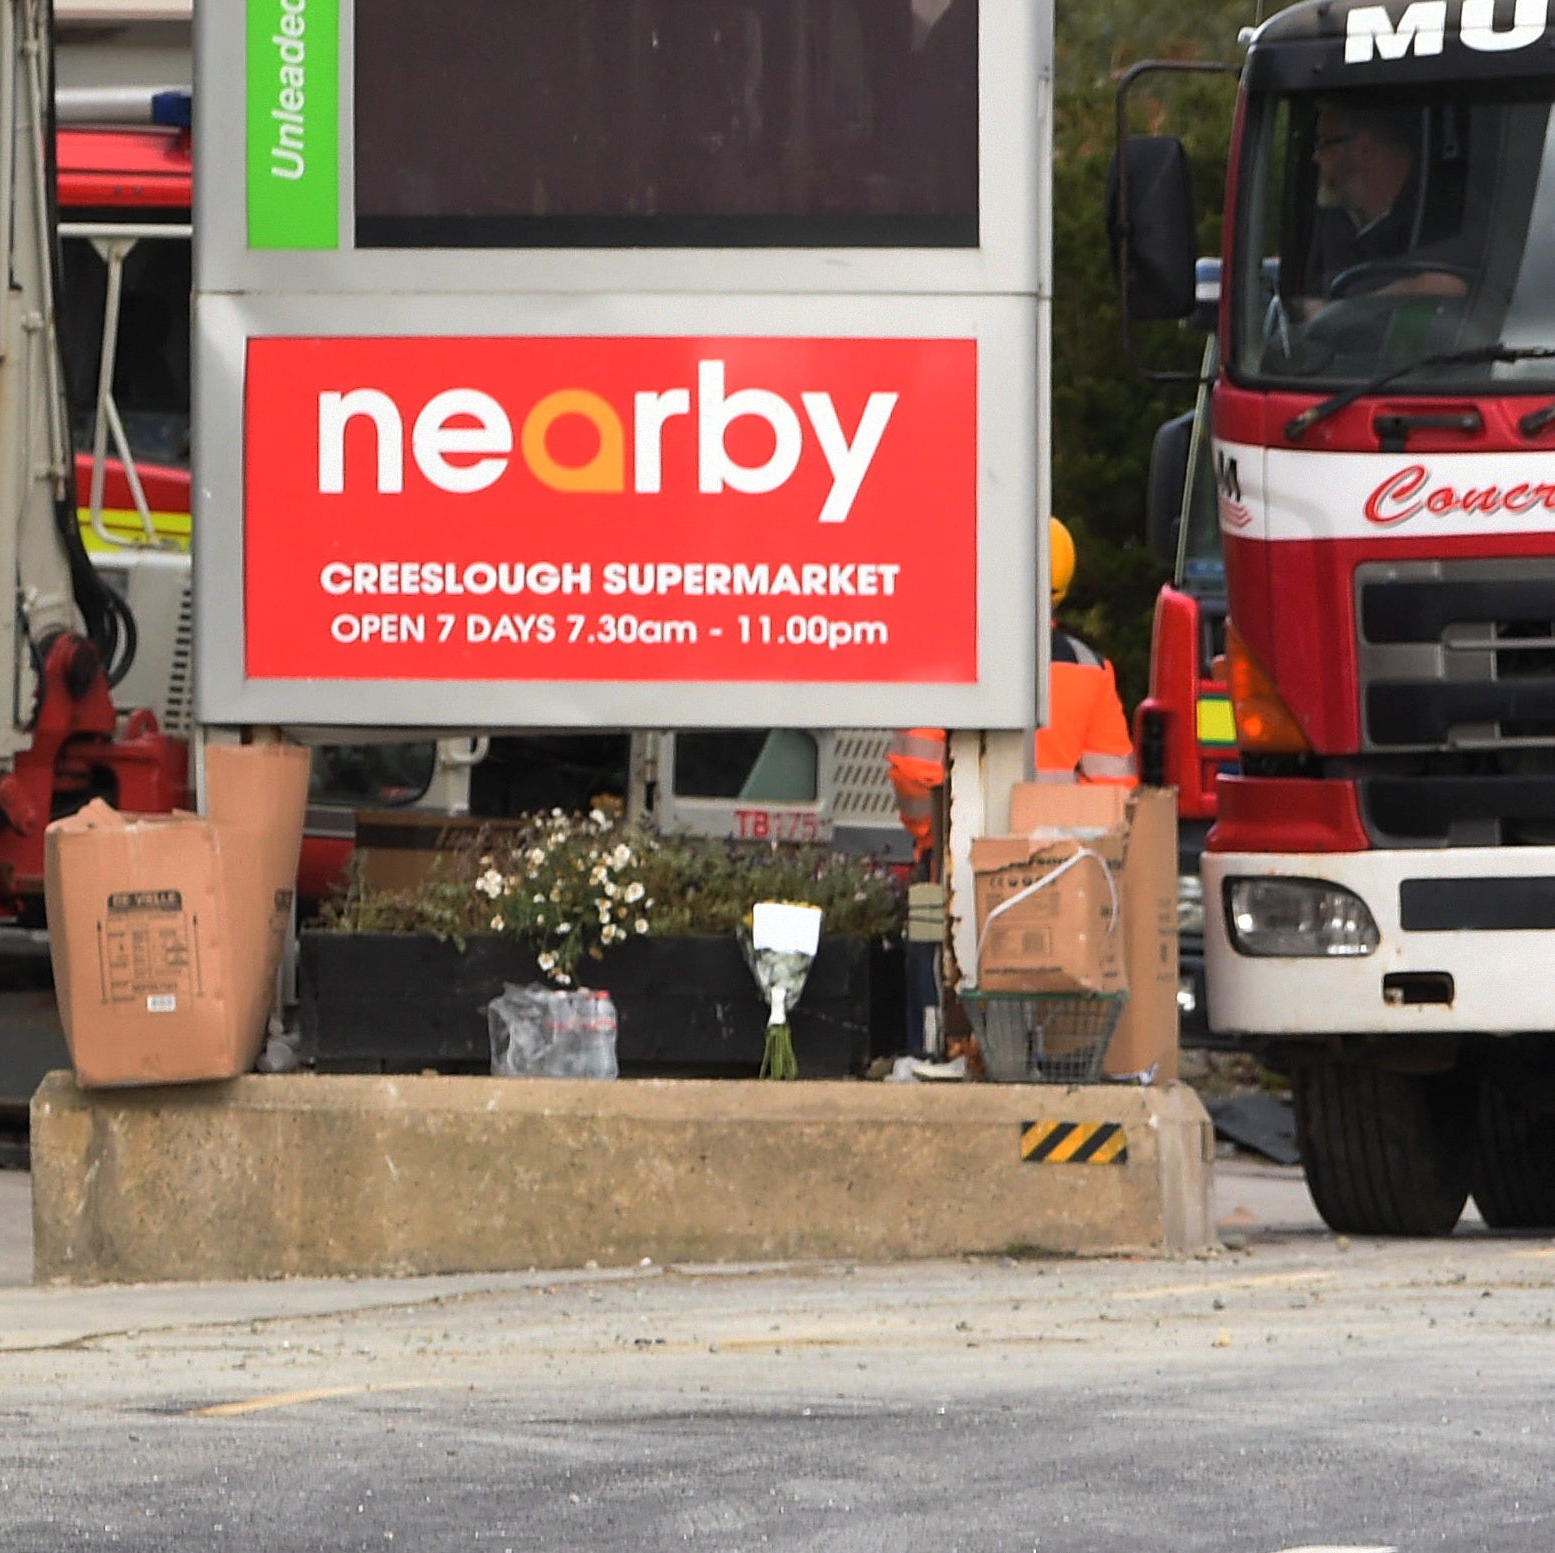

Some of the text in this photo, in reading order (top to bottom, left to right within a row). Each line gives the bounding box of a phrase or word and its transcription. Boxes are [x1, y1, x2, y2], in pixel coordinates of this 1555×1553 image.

[318, 359, 899, 523] nearby
[1363, 463, 1555, 529] Concr
[319, 561, 900, 596] CREESLOUGH SUPERMARKET
[330, 613, 425, 643] OPEN
[436, 614, 458, 643] 7
[466, 614, 556, 643] DAYS
[566, 614, 697, 644] 7.30am
[737, 615, 889, 649] 11.00pm
